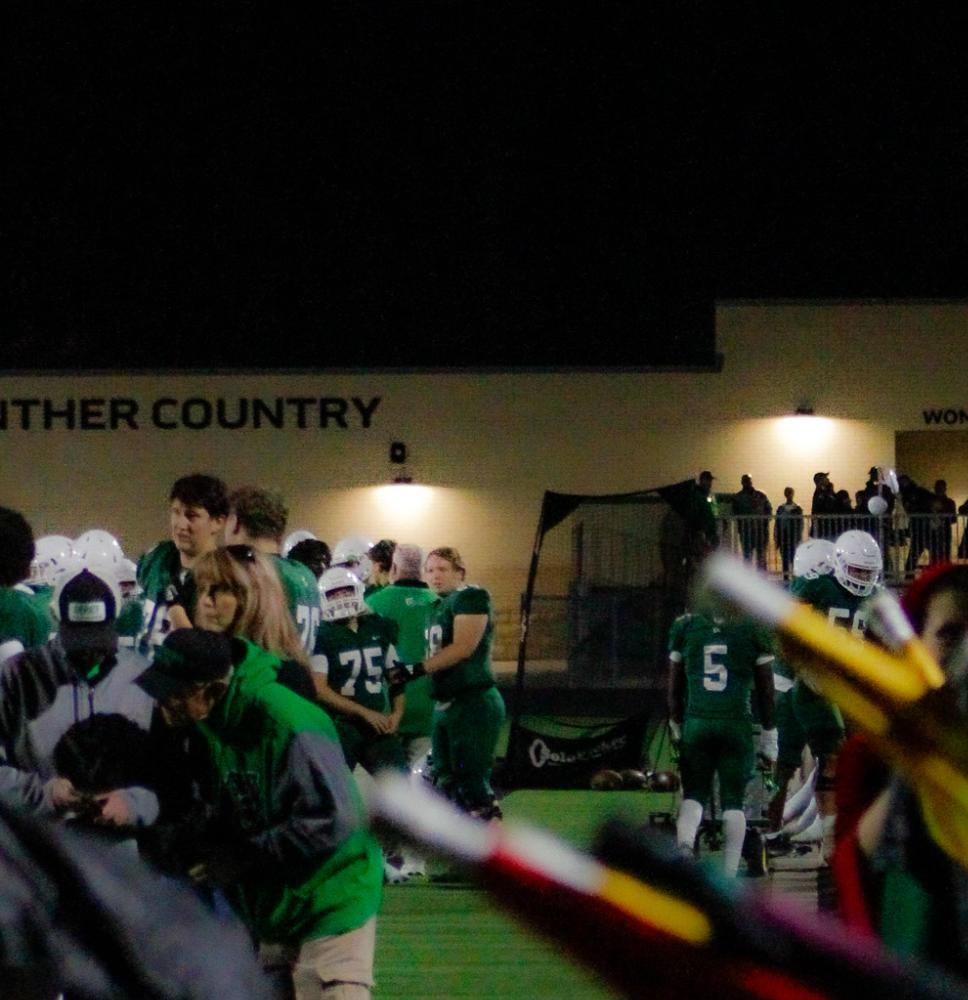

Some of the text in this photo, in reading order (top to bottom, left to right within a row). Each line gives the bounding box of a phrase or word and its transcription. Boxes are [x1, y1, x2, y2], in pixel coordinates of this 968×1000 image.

[0, 398, 381, 430] THER COUNTRY
[338, 646, 383, 696] 75
[703, 644, 728, 692] 5
